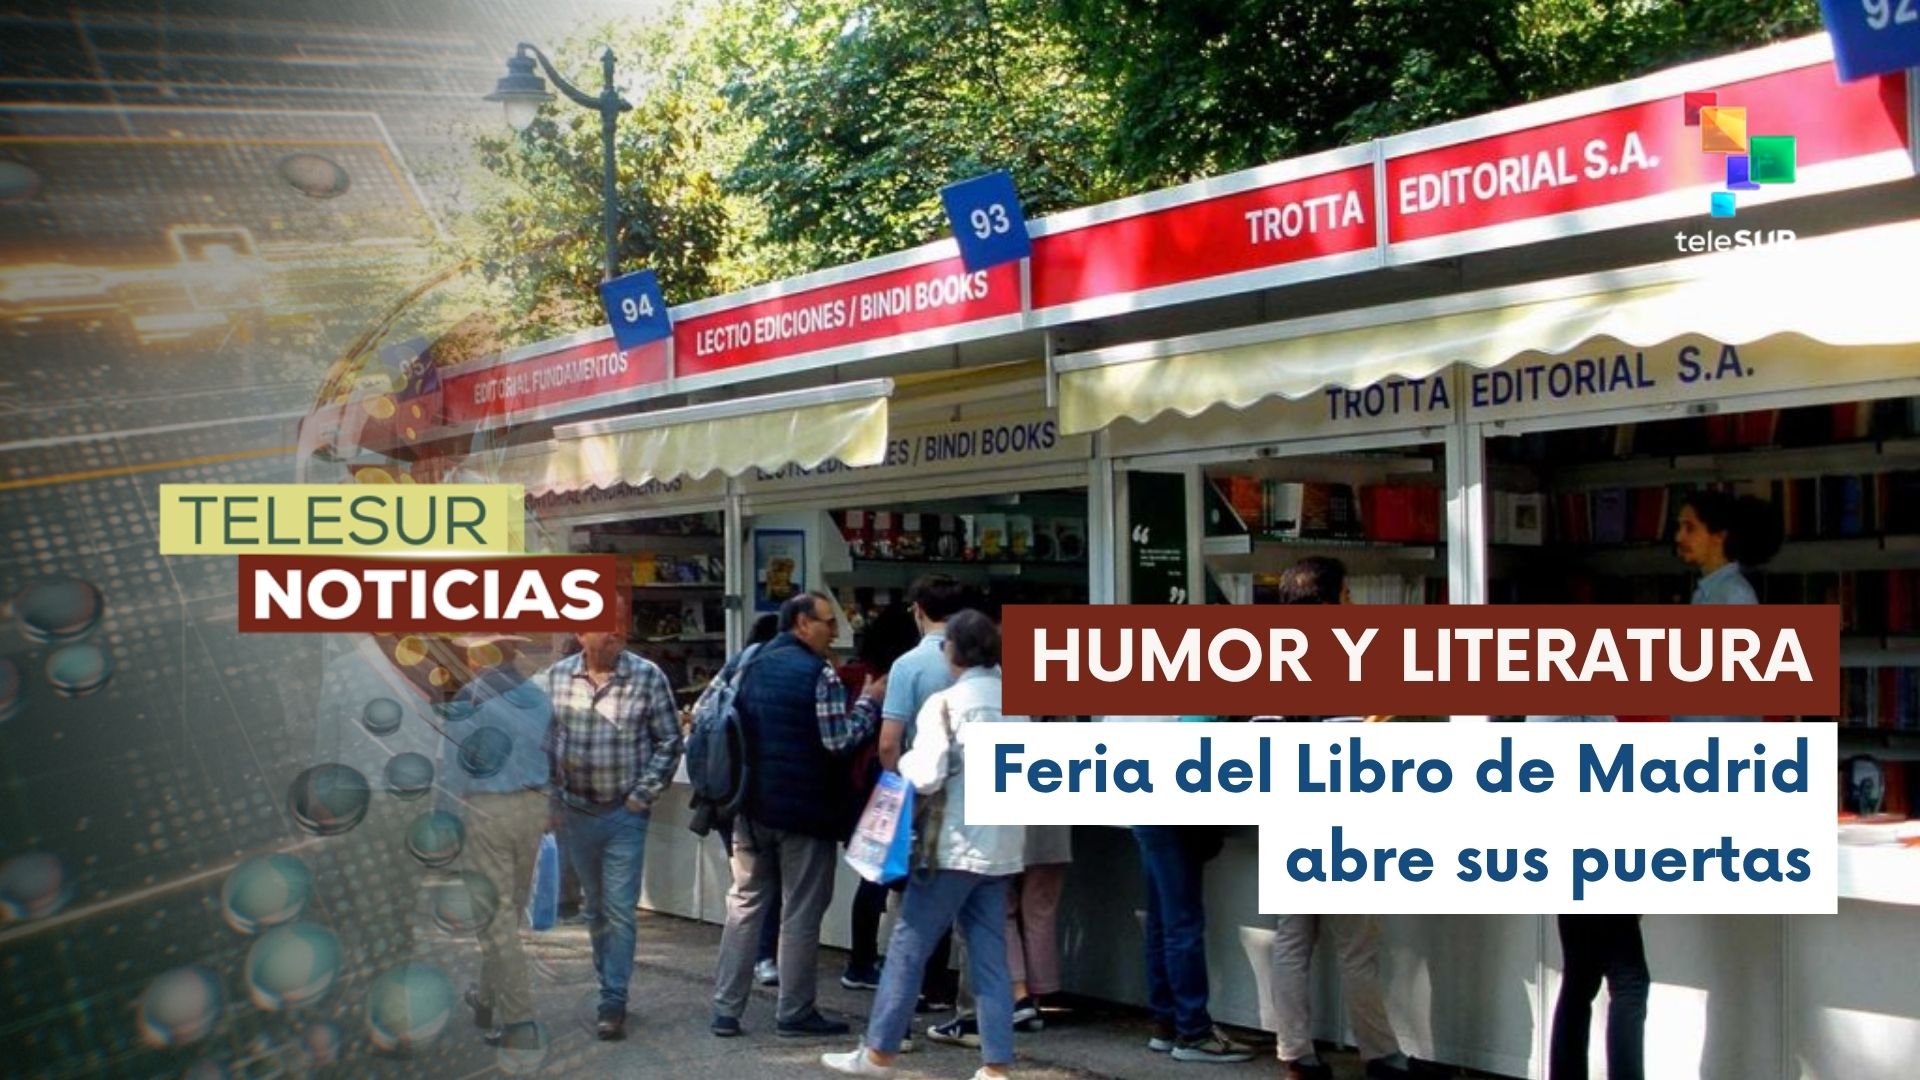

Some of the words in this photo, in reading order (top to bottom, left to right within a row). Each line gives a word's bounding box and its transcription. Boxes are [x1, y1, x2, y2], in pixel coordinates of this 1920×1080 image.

[1245, 190, 1365, 246] TROTTA
[1399, 146, 1577, 215] EDITORIAL
[1584, 131, 1661, 180] S.A.
[970, 203, 1010, 239] 93
[621, 293, 654, 323] 94
[697, 322, 751, 356] LECTIO
[754, 300, 845, 345] EDICIONES
[860, 285, 911, 321] BINDI
[915, 270, 989, 311] BOOKS
[473, 372, 531, 404] EDITORIAL
[531, 351, 628, 393] FUNDAMENTOS
[1326, 377, 1450, 420] TROTTA
[1472, 352, 1655, 408] EDITORIAL
[1677, 345, 1755, 383] S.A.
[925, 431, 976, 462] BINDI
[982, 421, 1056, 455] BOOKS
